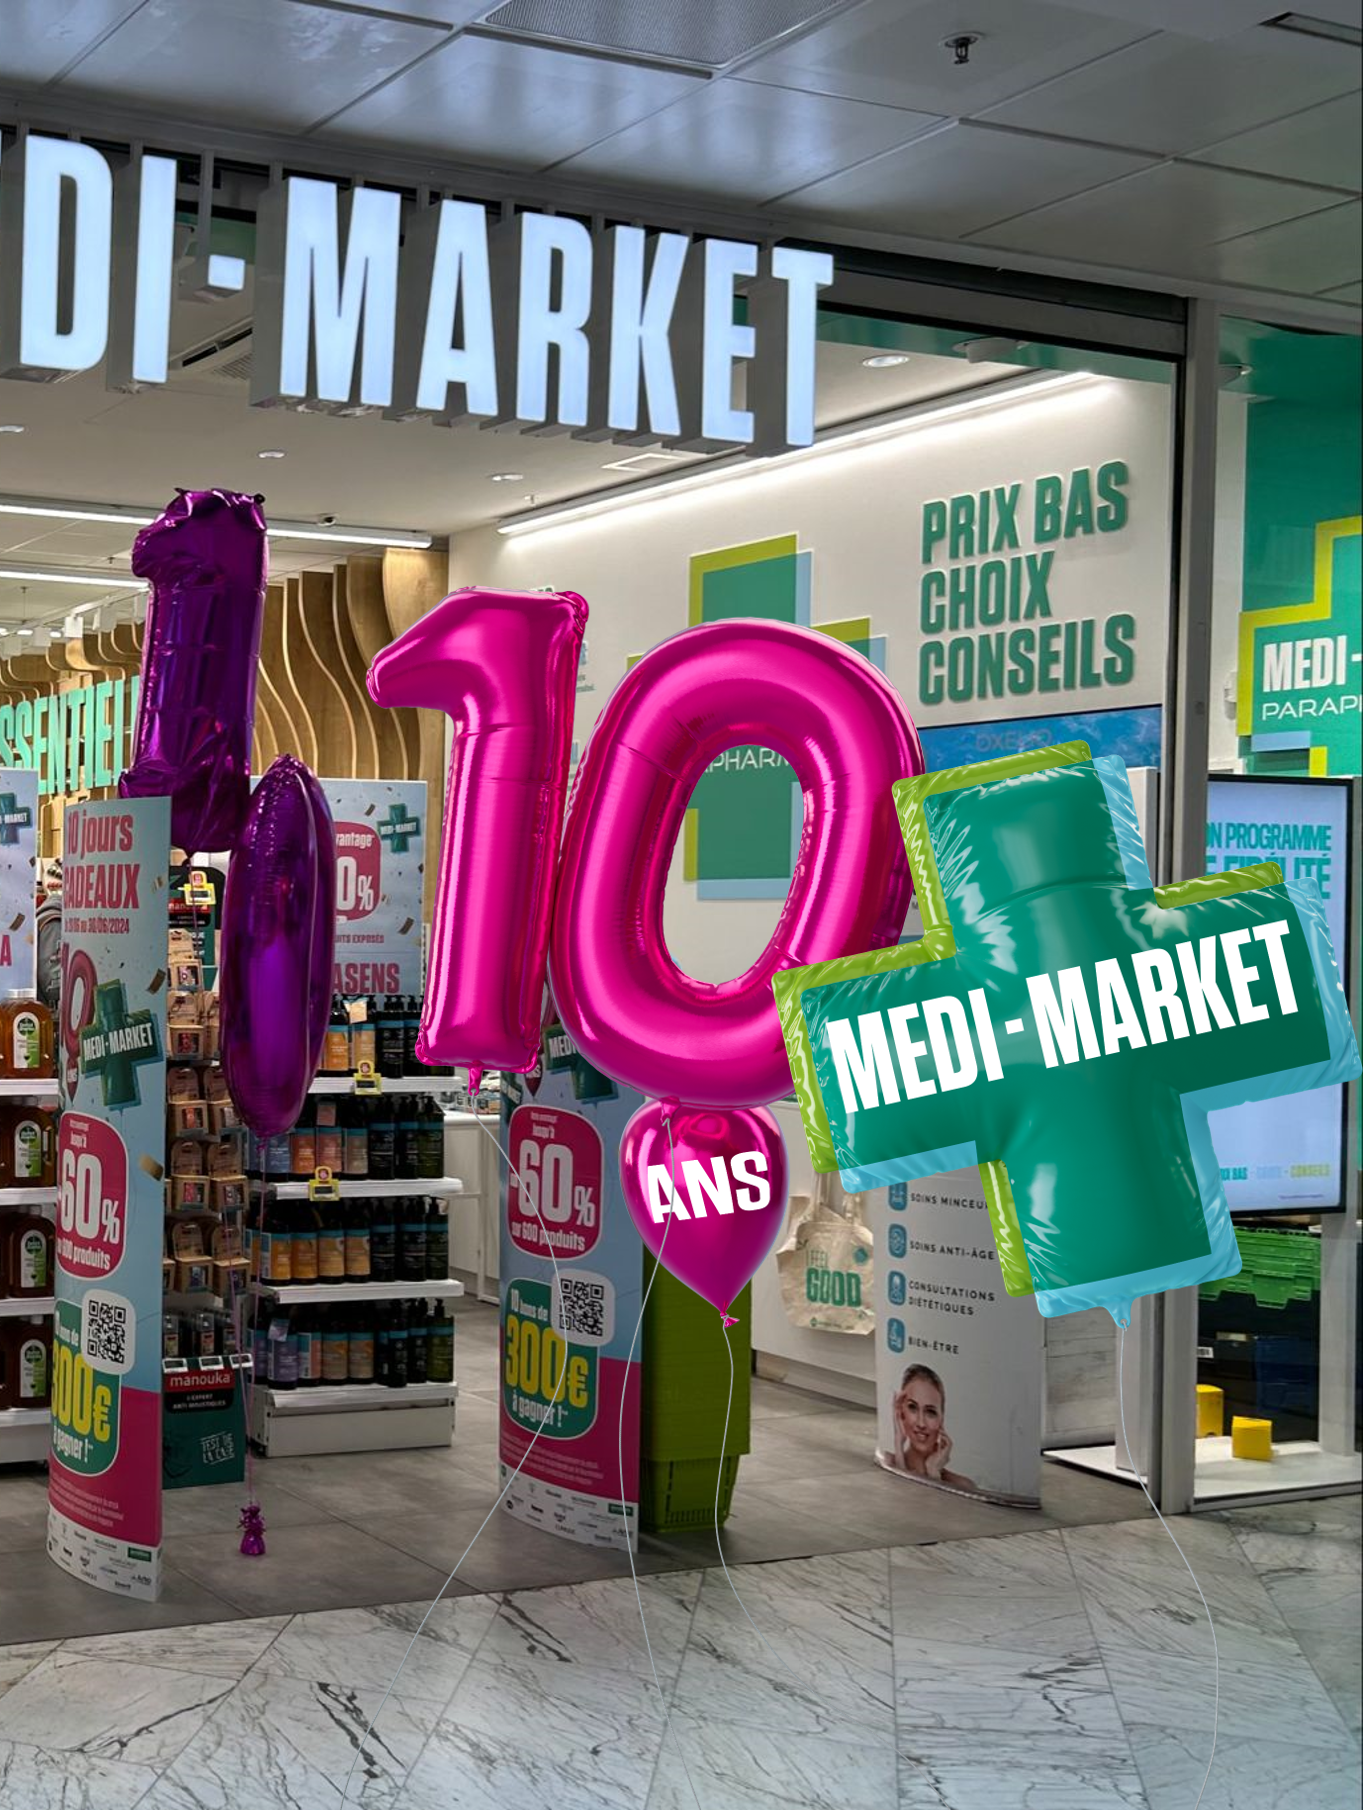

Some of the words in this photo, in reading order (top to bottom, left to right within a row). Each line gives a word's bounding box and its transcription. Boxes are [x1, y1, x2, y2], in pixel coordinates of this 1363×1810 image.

[921, 483, 1022, 566] PRIX
[1035, 460, 1130, 544] BAS
[920, 550, 1056, 636] CHOIX
[918, 612, 1137, 705] CONSEILS
[81, 809, 134, 859] jours
[1225, 822, 1332, 851] PROGRAMME
[333, 962, 400, 995] ASENS
[82, 1022, 154, 1061] MEDI-MARKET
[910, 1193, 937, 1205] SOINS
[539, 1229, 585, 1251] produits
[910, 1241, 936, 1253] SOINS
[939, 1246, 995, 1260] ANTI-ÂGE
[73, 1243, 111, 1271] produits
[806, 1267, 862, 1308] GOOD
[909, 1280, 995, 1301] CONSULTATIONS
[505, 1314, 589, 1408] 300€
[170, 1371, 231, 1387] manouka
[519, 1397, 555, 1425] gagner
